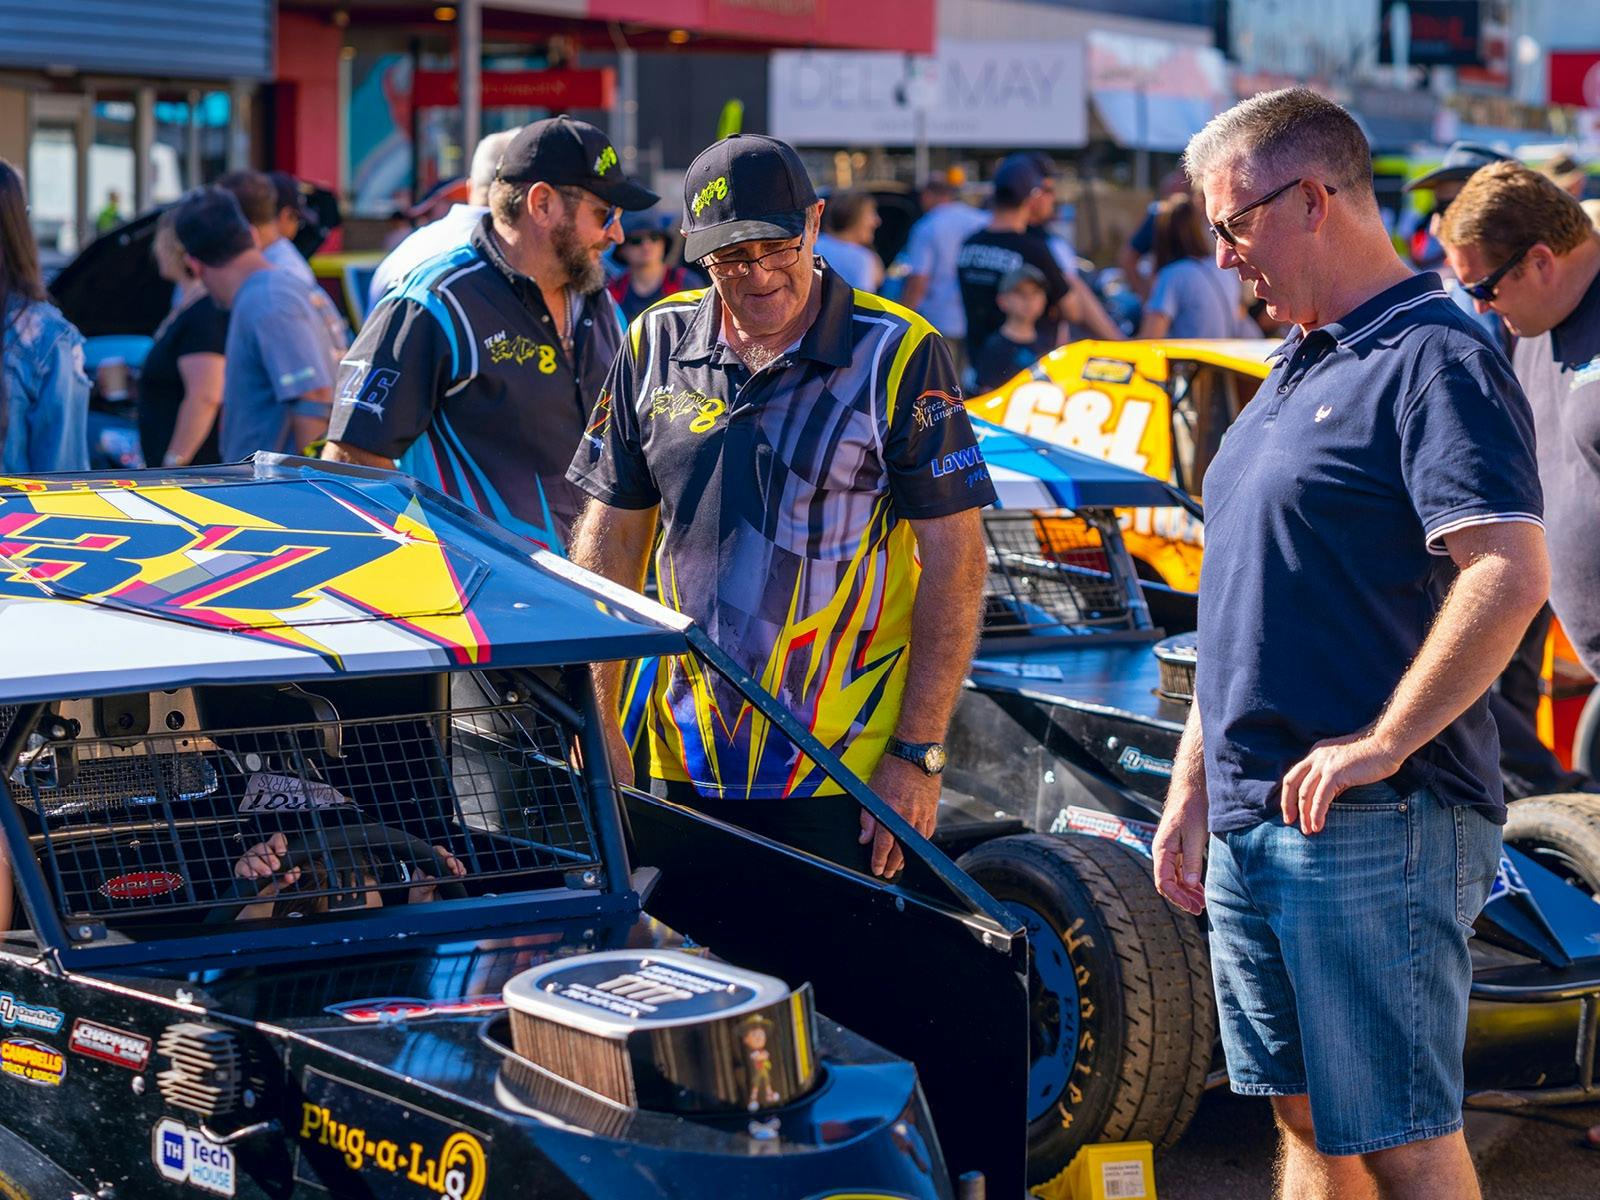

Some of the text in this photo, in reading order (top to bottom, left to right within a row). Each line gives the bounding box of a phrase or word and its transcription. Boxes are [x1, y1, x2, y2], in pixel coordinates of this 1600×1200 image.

[946, 58, 1064, 106] MAY
[538, 344, 557, 374] 8
[689, 398, 726, 433] 8
[165, 1140, 183, 1161] TH
[191, 1137, 230, 1170] Tech
[193, 1164, 230, 1188] HOUSE
